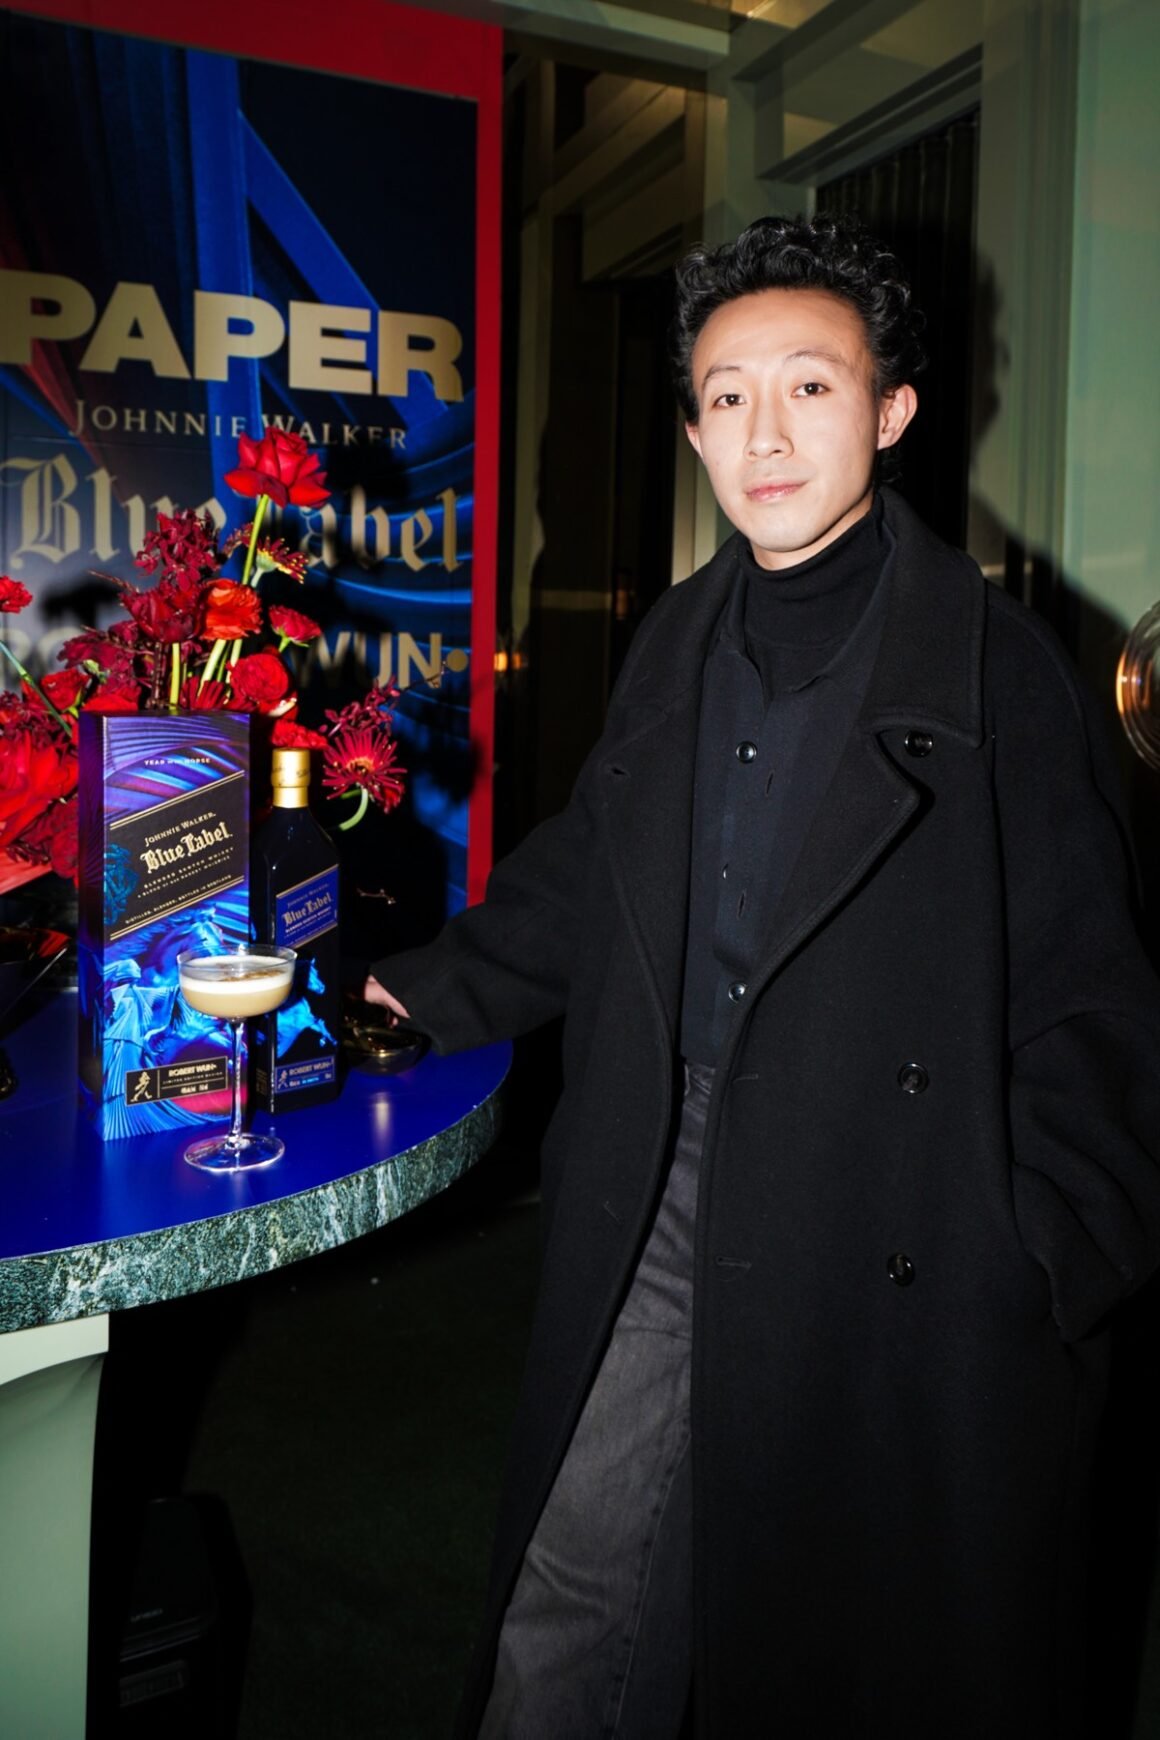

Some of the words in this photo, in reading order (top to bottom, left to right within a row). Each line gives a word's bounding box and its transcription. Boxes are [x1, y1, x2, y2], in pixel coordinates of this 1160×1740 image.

[0, 268, 465, 402] PAPER
[69, 400, 247, 439] JOHNNIE
[257, 484, 463, 572] abel
[140, 844, 186, 874] Blue
[180, 821, 233, 857] Label
[144, 826, 181, 847] JOHNNIE
